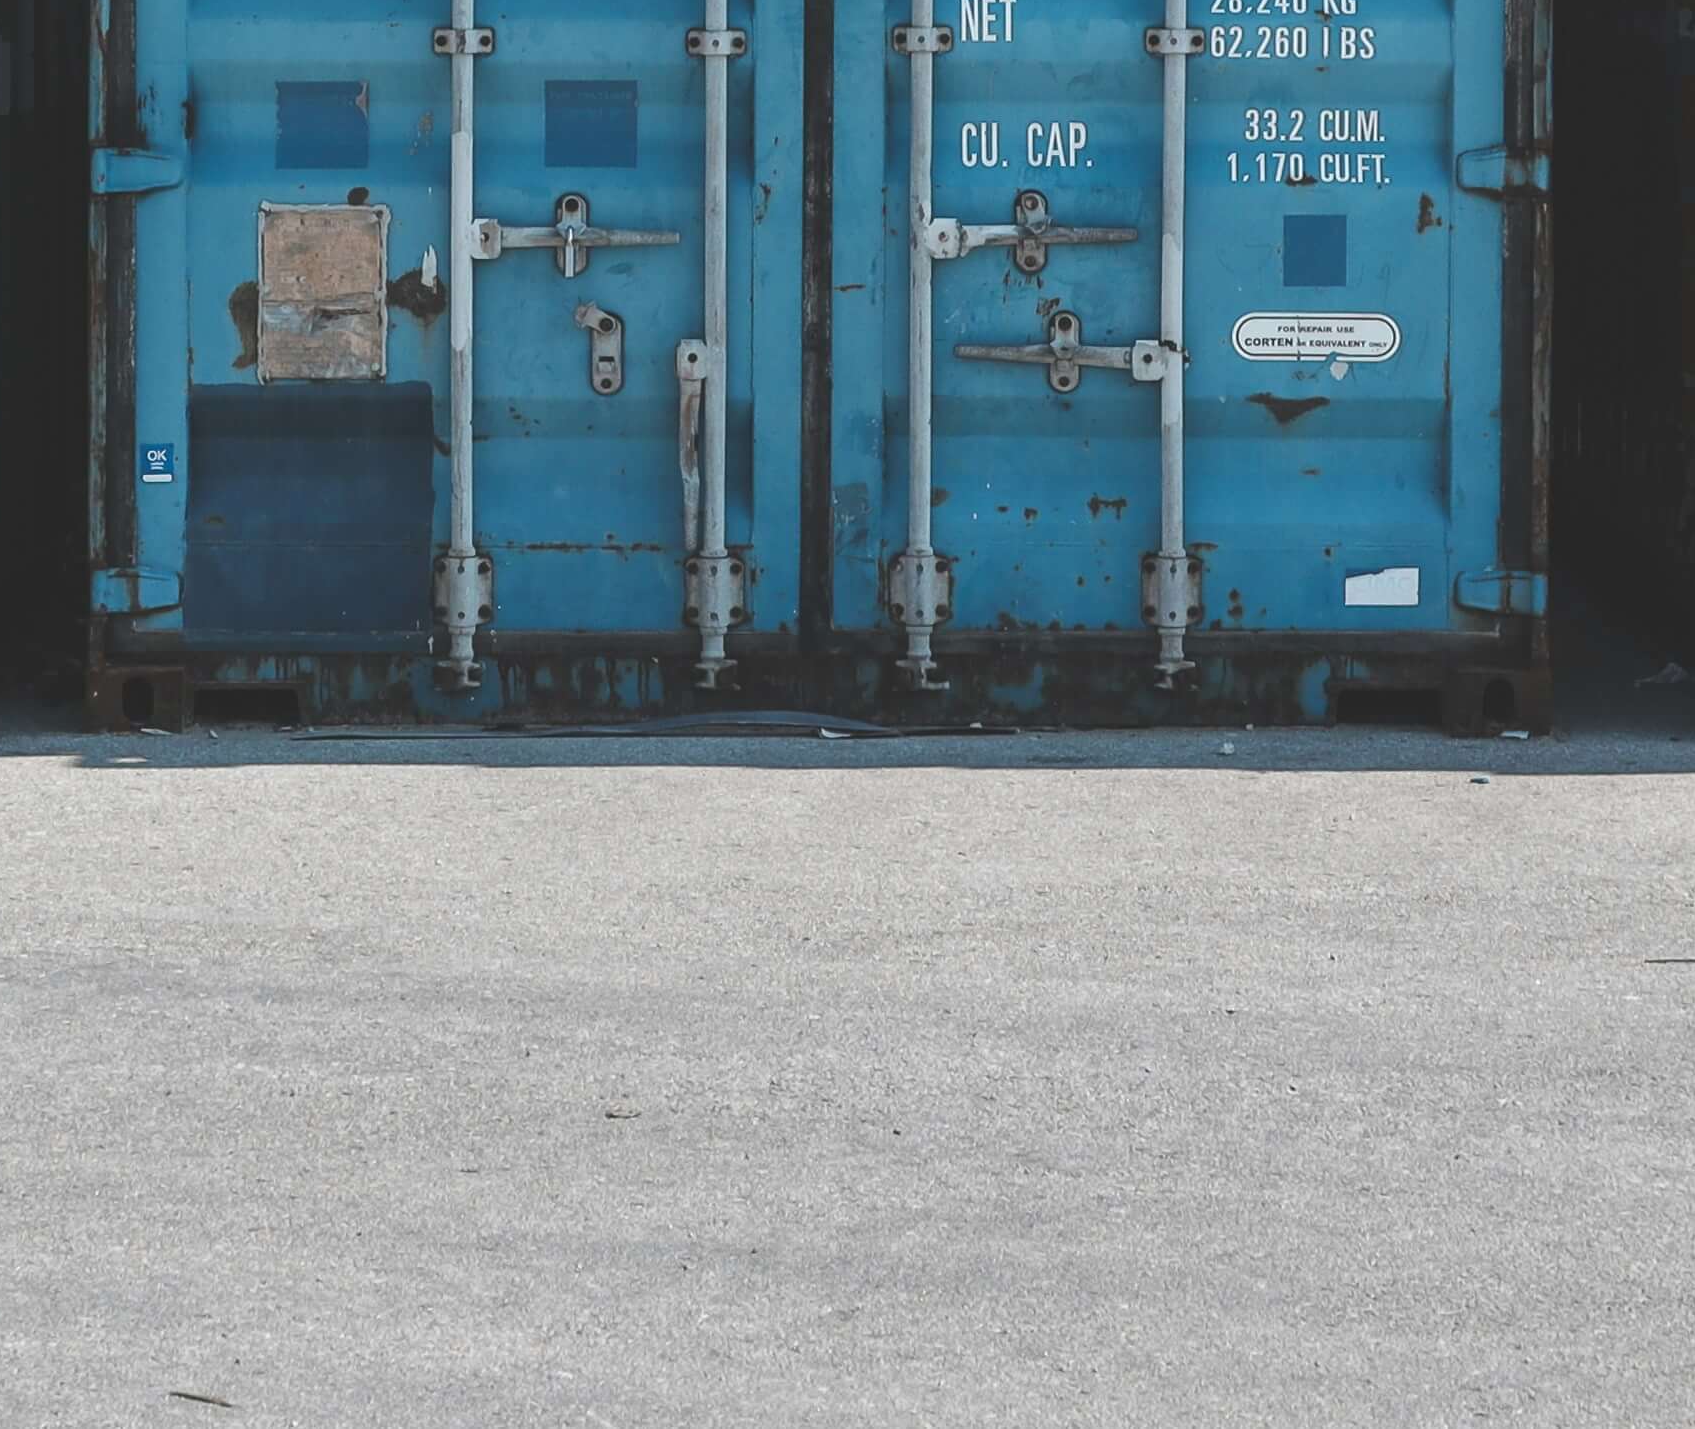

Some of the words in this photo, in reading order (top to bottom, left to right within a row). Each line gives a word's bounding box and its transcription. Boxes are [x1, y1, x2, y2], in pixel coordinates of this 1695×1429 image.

[1211, 26, 1307, 58] 62,260
[1245, 109, 1304, 142] 33.2
[961, 122, 1008, 167] CU.
[1027, 122, 1093, 167] CAP.
[1277, 325, 1296, 333] FOR
[1244, 337, 1294, 347] CORTEN
[1309, 340, 1367, 348] EQUIVALENT
[147, 449, 168, 461] OK
